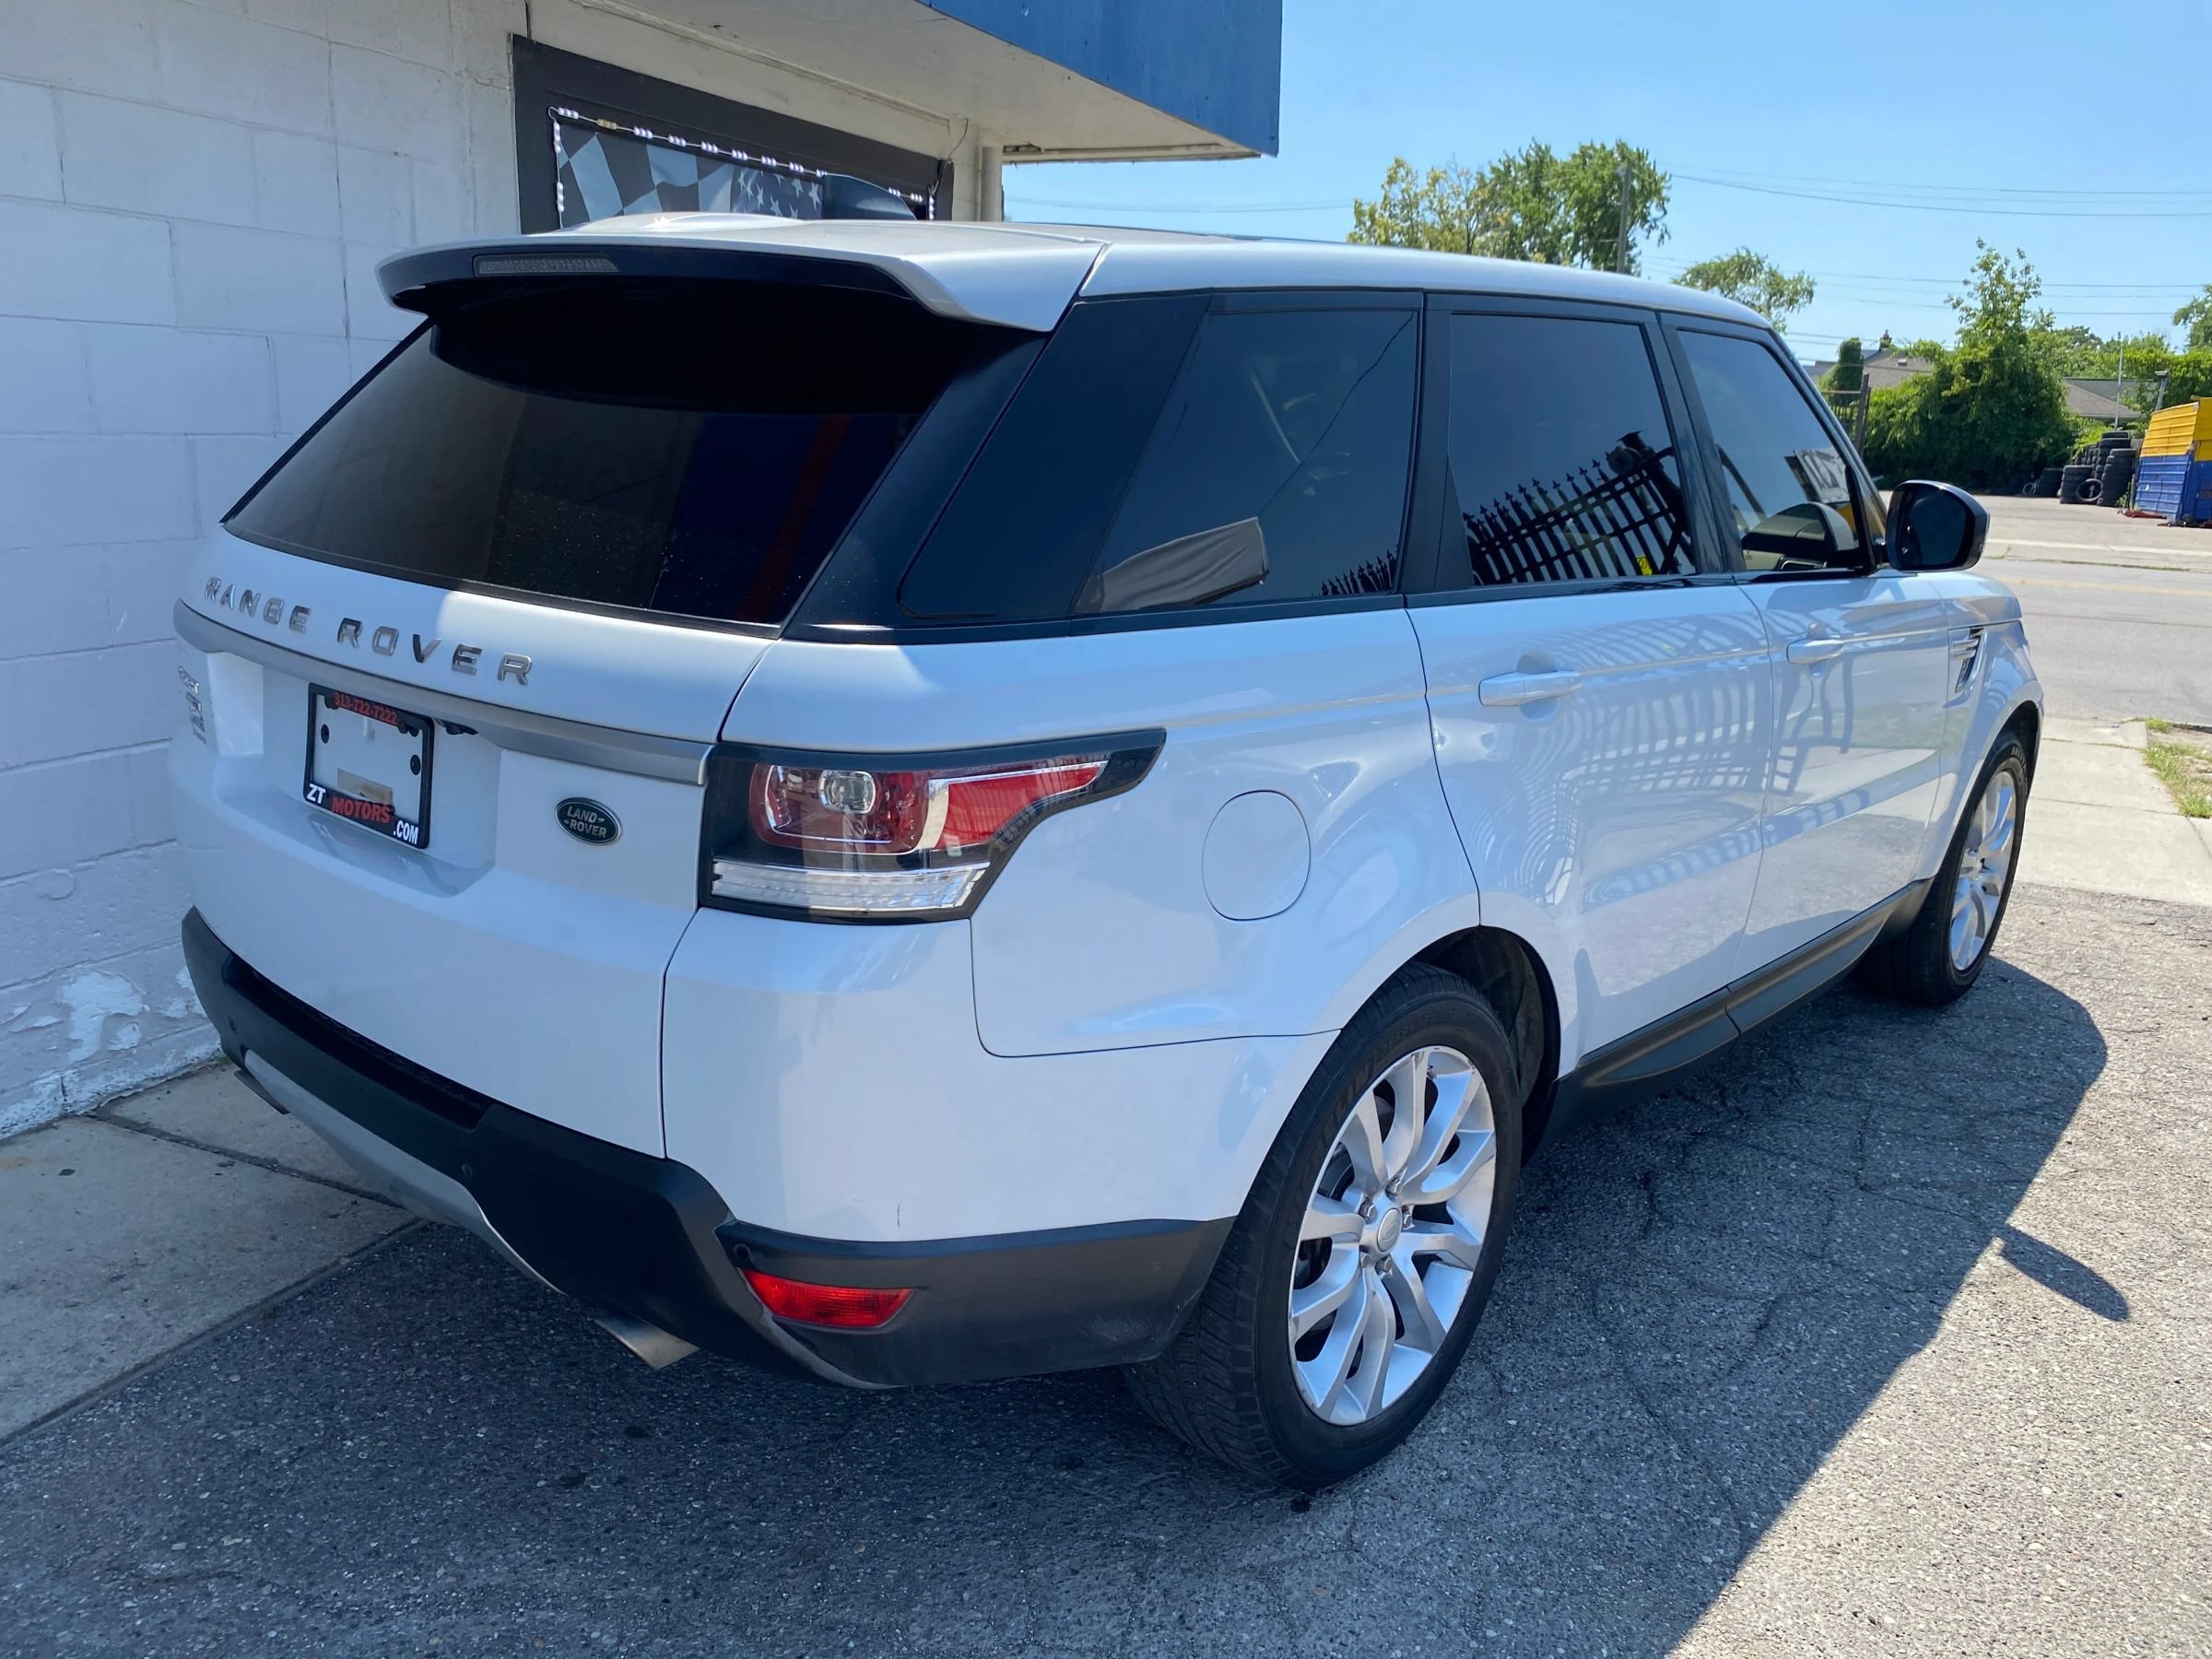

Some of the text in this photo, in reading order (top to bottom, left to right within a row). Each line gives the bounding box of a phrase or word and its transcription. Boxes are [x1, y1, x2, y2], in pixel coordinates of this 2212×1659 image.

[204, 576, 532, 686] RANGE ROVER
[306, 783, 418, 845] ZT MOTORS .COM
[567, 806, 597, 823] LAND
[570, 818, 607, 838] ROVER
